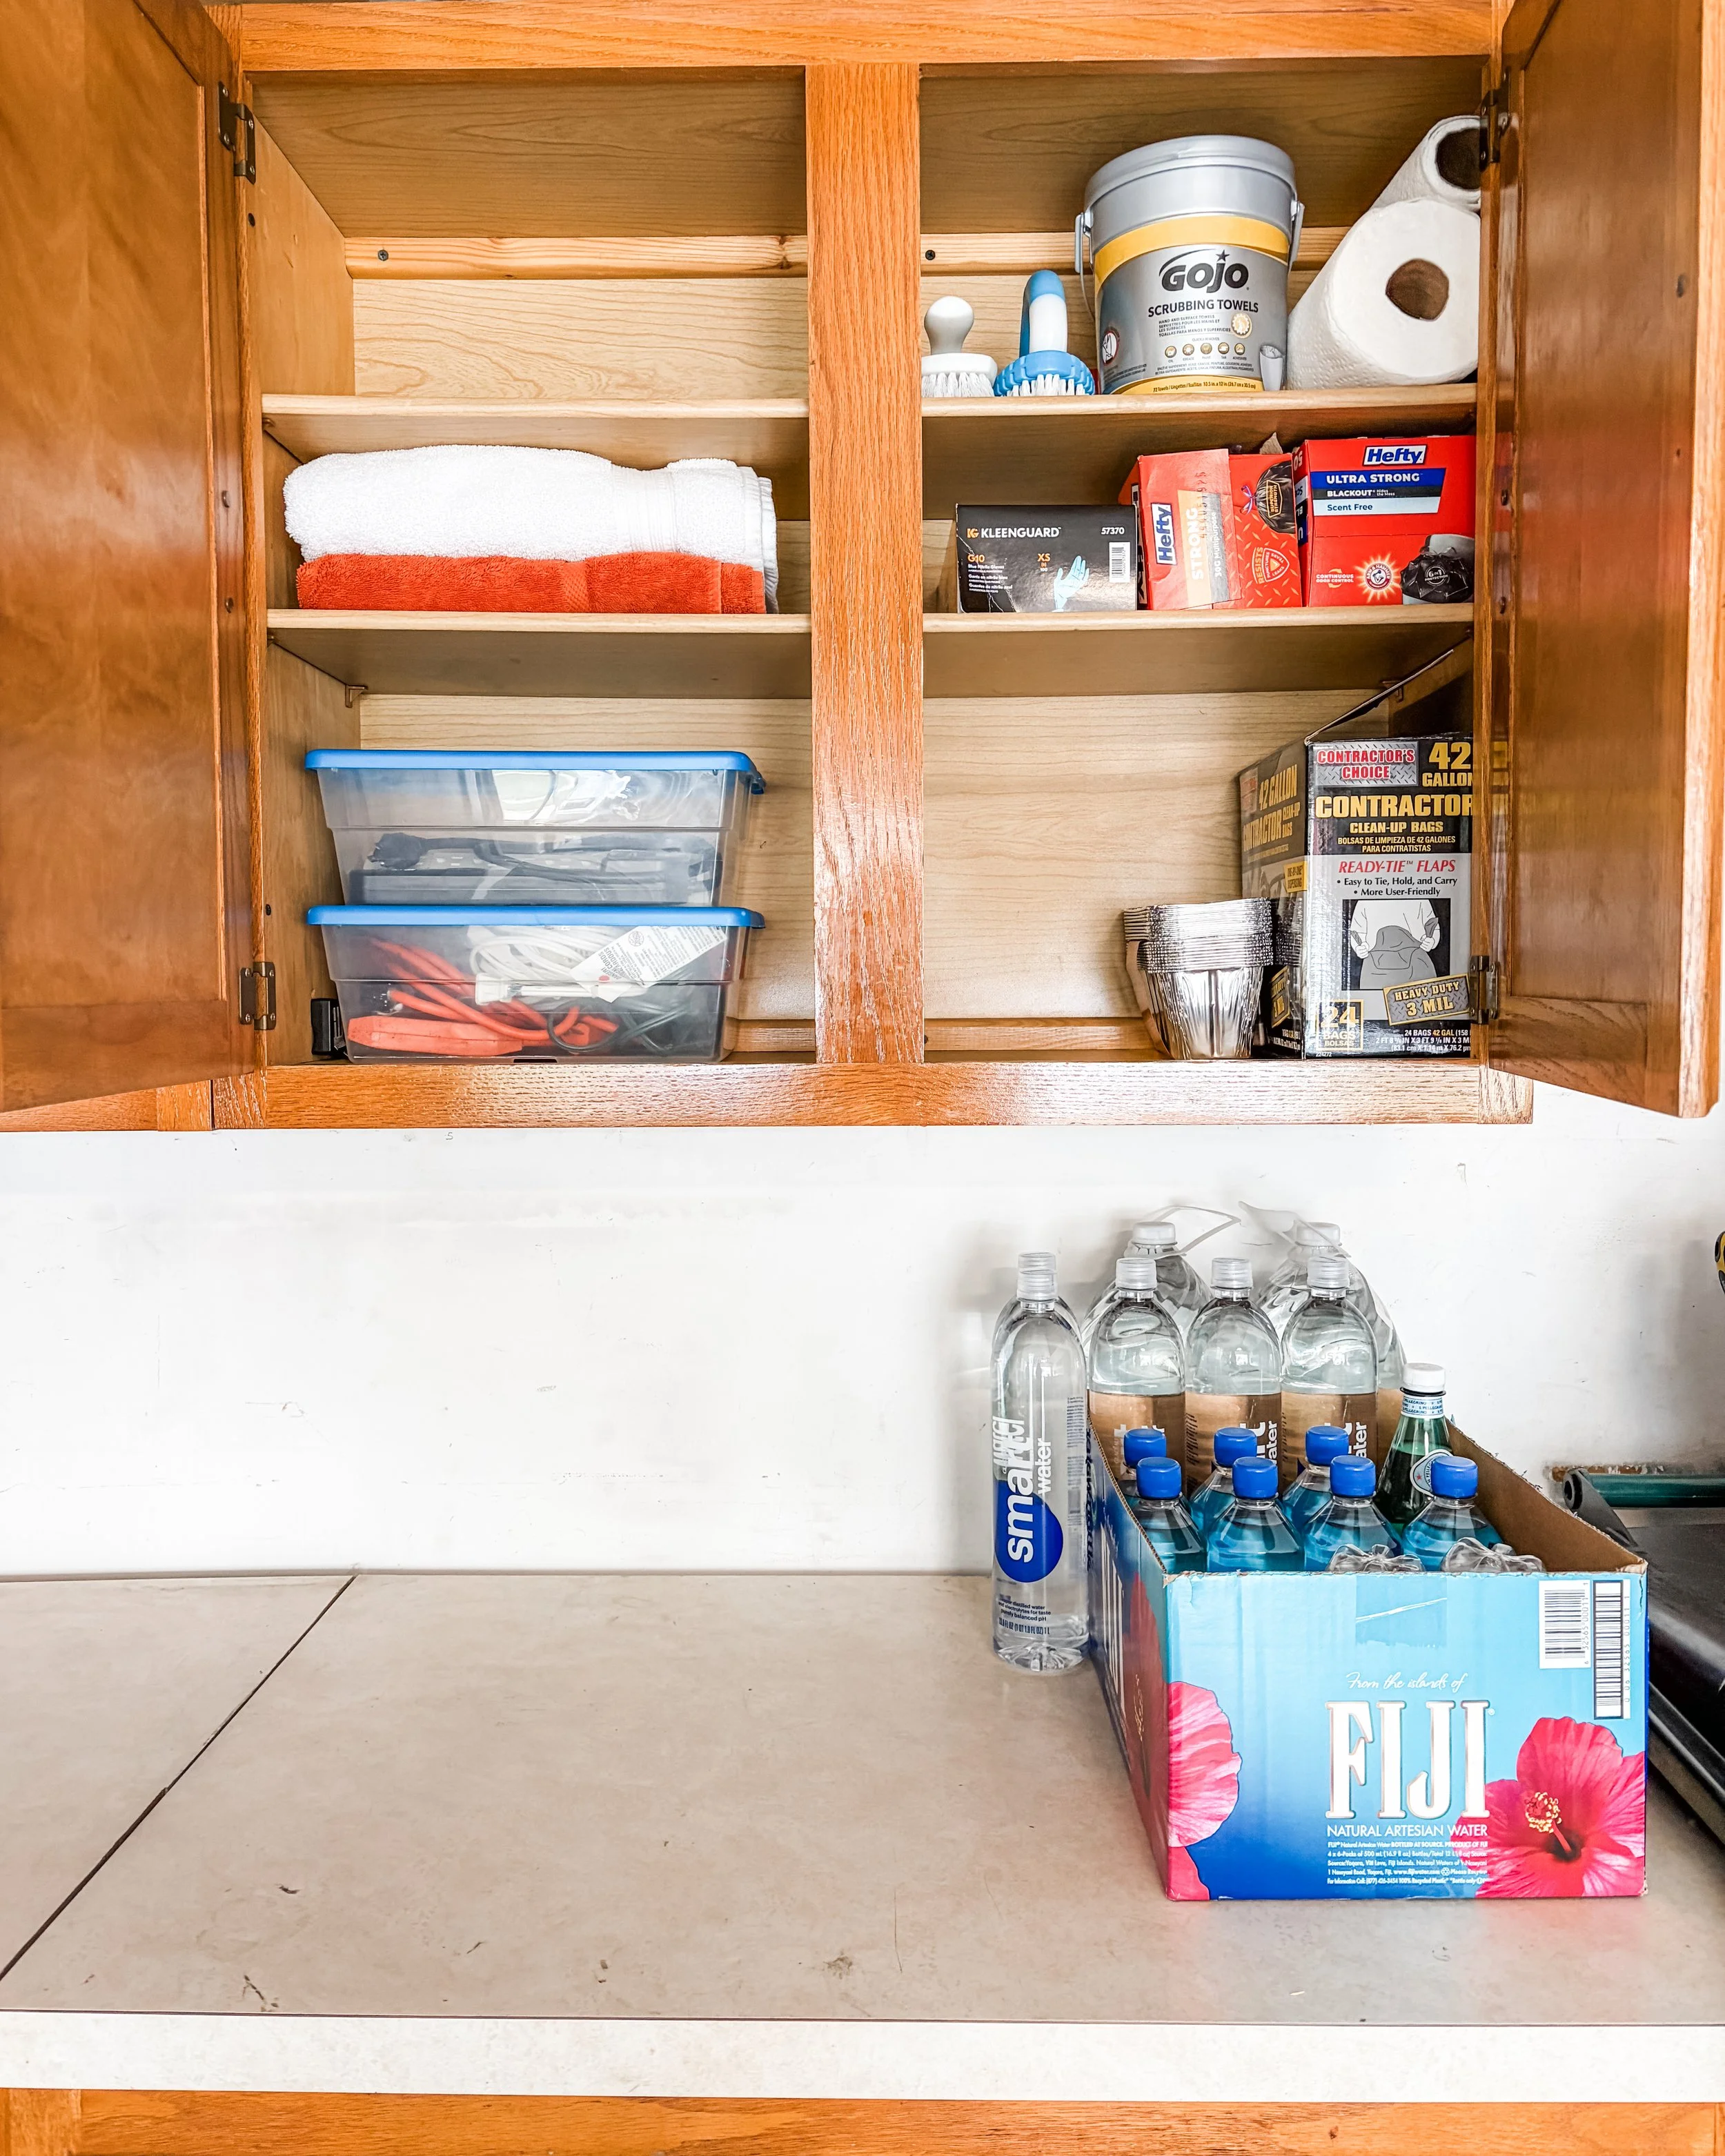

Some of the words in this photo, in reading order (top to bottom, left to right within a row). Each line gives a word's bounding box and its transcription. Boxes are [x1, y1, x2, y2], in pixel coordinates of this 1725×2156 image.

[1161, 262, 1250, 293] GOJO
[1148, 300, 1214, 317] SCRUBBING
[1217, 299, 1259, 313] TOWELS
[1293, 451, 1303, 471] 50
[1367, 448, 1423, 464] Hefty
[1327, 475, 1367, 484] ULTRA
[1370, 473, 1420, 483] STRONG
[1156, 506, 1173, 561] Hefty
[1210, 512, 1222, 561] Multipurpose
[1185, 507, 1203, 580] STRONG
[967, 554, 985, 563] G10
[1037, 553, 1051, 562] XS
[1255, 547, 1265, 584] RESISTS
[1271, 553, 1284, 563] TEARS
[1272, 566, 1285, 576] LEAKS
[1317, 749, 1415, 764] CONTRACTOR'S
[1429, 742, 1471, 770] 42
[1342, 765, 1390, 780] CHOICE
[1259, 779, 1269, 811] 42
[1269, 764, 1297, 806] GALLON
[1282, 801, 1300, 821] CLEAN-UP
[1315, 794, 1473, 818] CONTRACTOR
[1282, 821, 1293, 838] BAGS
[1349, 822, 1407, 834] CLEAN-UP
[1411, 821, 1443, 833] BAGS
[1338, 837, 1364, 845] BOLSAS
[1417, 860, 1456, 873] FLAPS
[1344, 878, 1362, 887] Easy
[1373, 877, 1390, 887] Tie,
[1392, 877, 1414, 886] Hold,
[1417, 877, 1432, 885] and
[1434, 877, 1457, 887] Carry
[1361, 888, 1383, 896] More
[1385, 887, 1441, 897] User-Friendly
[1395, 989, 1429, 1002] HEAVY
[1431, 981, 1460, 995] DUTY
[1406, 1003, 1420, 1017] 3
[1422, 995, 1454, 1013] MIL
[1321, 1006, 1359, 1028] 24
[1323, 1030, 1356, 1040] BAGS
[1266, 1421, 1277, 1460] ater
[1353, 1422, 1367, 1458] ater
[1037, 1438, 1051, 1495] water
[1007, 1437, 1034, 1563] smart
[1005, 1604, 1030, 1614] electrolytes
[1014, 1613, 1038, 1621] balanced
[1346, 1672, 1379, 1689] From
[1383, 1671, 1405, 1689] the
[1407, 1672, 1447, 1689] islands
[1451, 1672, 1469, 1693] of
[1625, 1680, 1630, 1690] 06
[1325, 1700, 1490, 1819] FIJI
[1327, 1825, 1382, 1837] NATURAL
[1385, 1824, 1443, 1837] ARTESIAN
[1448, 1824, 1488, 1836] WATER
